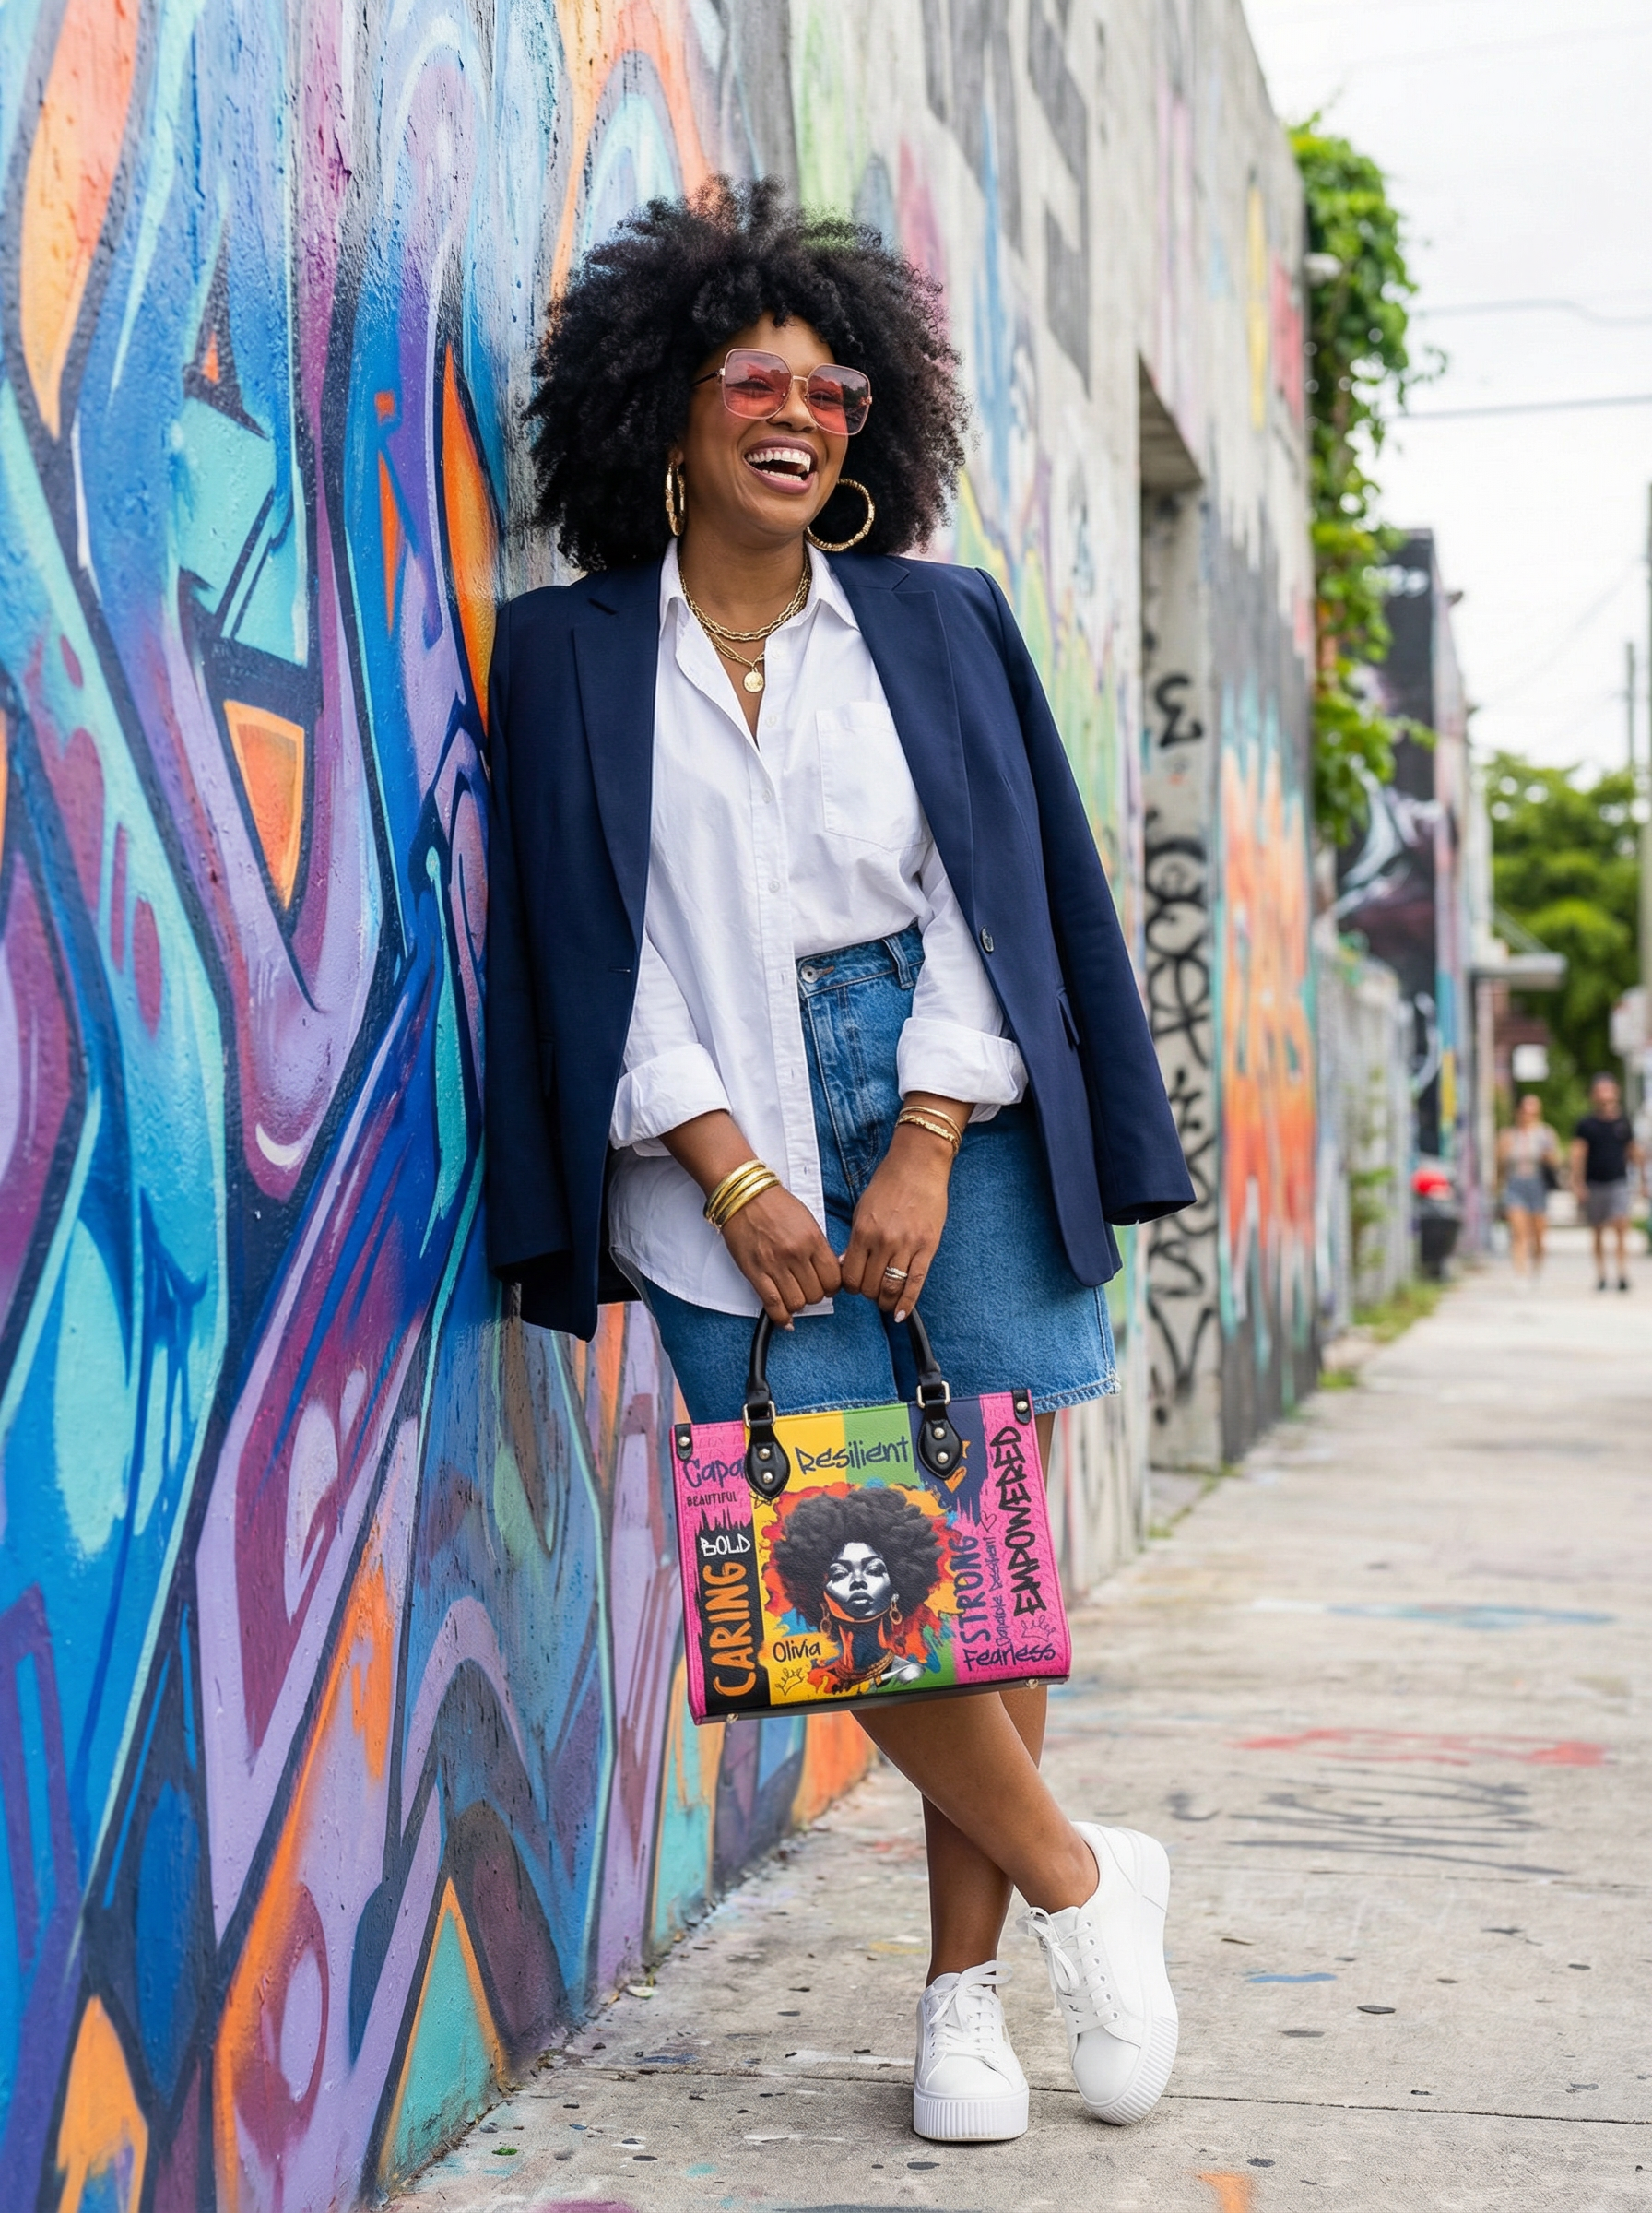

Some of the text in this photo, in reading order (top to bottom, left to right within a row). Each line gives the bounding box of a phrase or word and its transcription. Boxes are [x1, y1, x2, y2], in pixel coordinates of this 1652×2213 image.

[682, 1454, 746, 1488] Capa
[795, 1435, 909, 1475] Resilient
[686, 1490, 738, 1508] BEAUTIFUL
[990, 1426, 1047, 1616] EMPOWERED
[700, 1533, 751, 1556] BOLD
[948, 1535, 992, 1645] STRONG
[702, 1561, 757, 1697] CARING
[772, 1639, 822, 1663] Olivia
[962, 1642, 1056, 1672] Fearless
